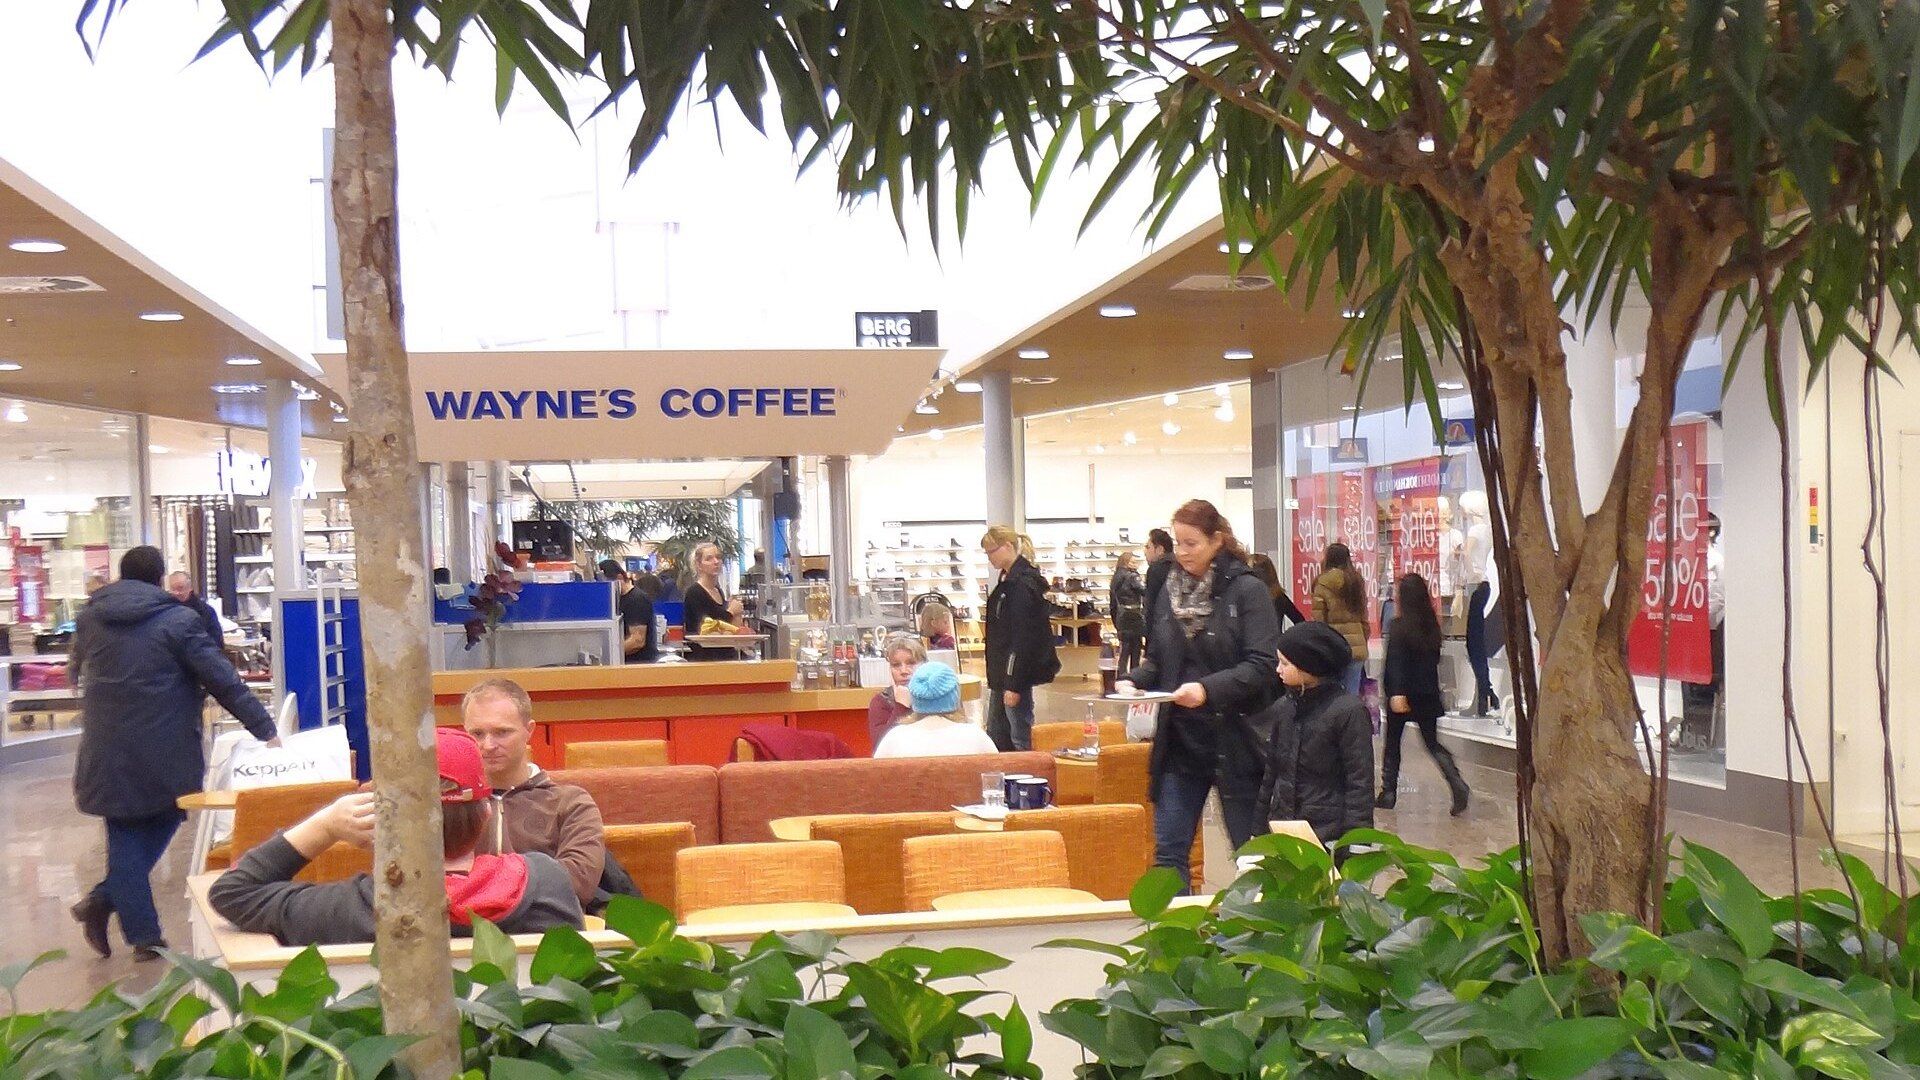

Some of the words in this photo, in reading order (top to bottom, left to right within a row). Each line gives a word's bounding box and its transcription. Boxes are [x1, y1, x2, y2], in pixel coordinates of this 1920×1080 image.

[862, 317, 912, 336] BERG
[425, 389, 637, 420] WAYNE'S
[660, 388, 836, 418] COFFEE
[1298, 510, 1325, 553] sale
[1399, 500, 1436, 549] sale
